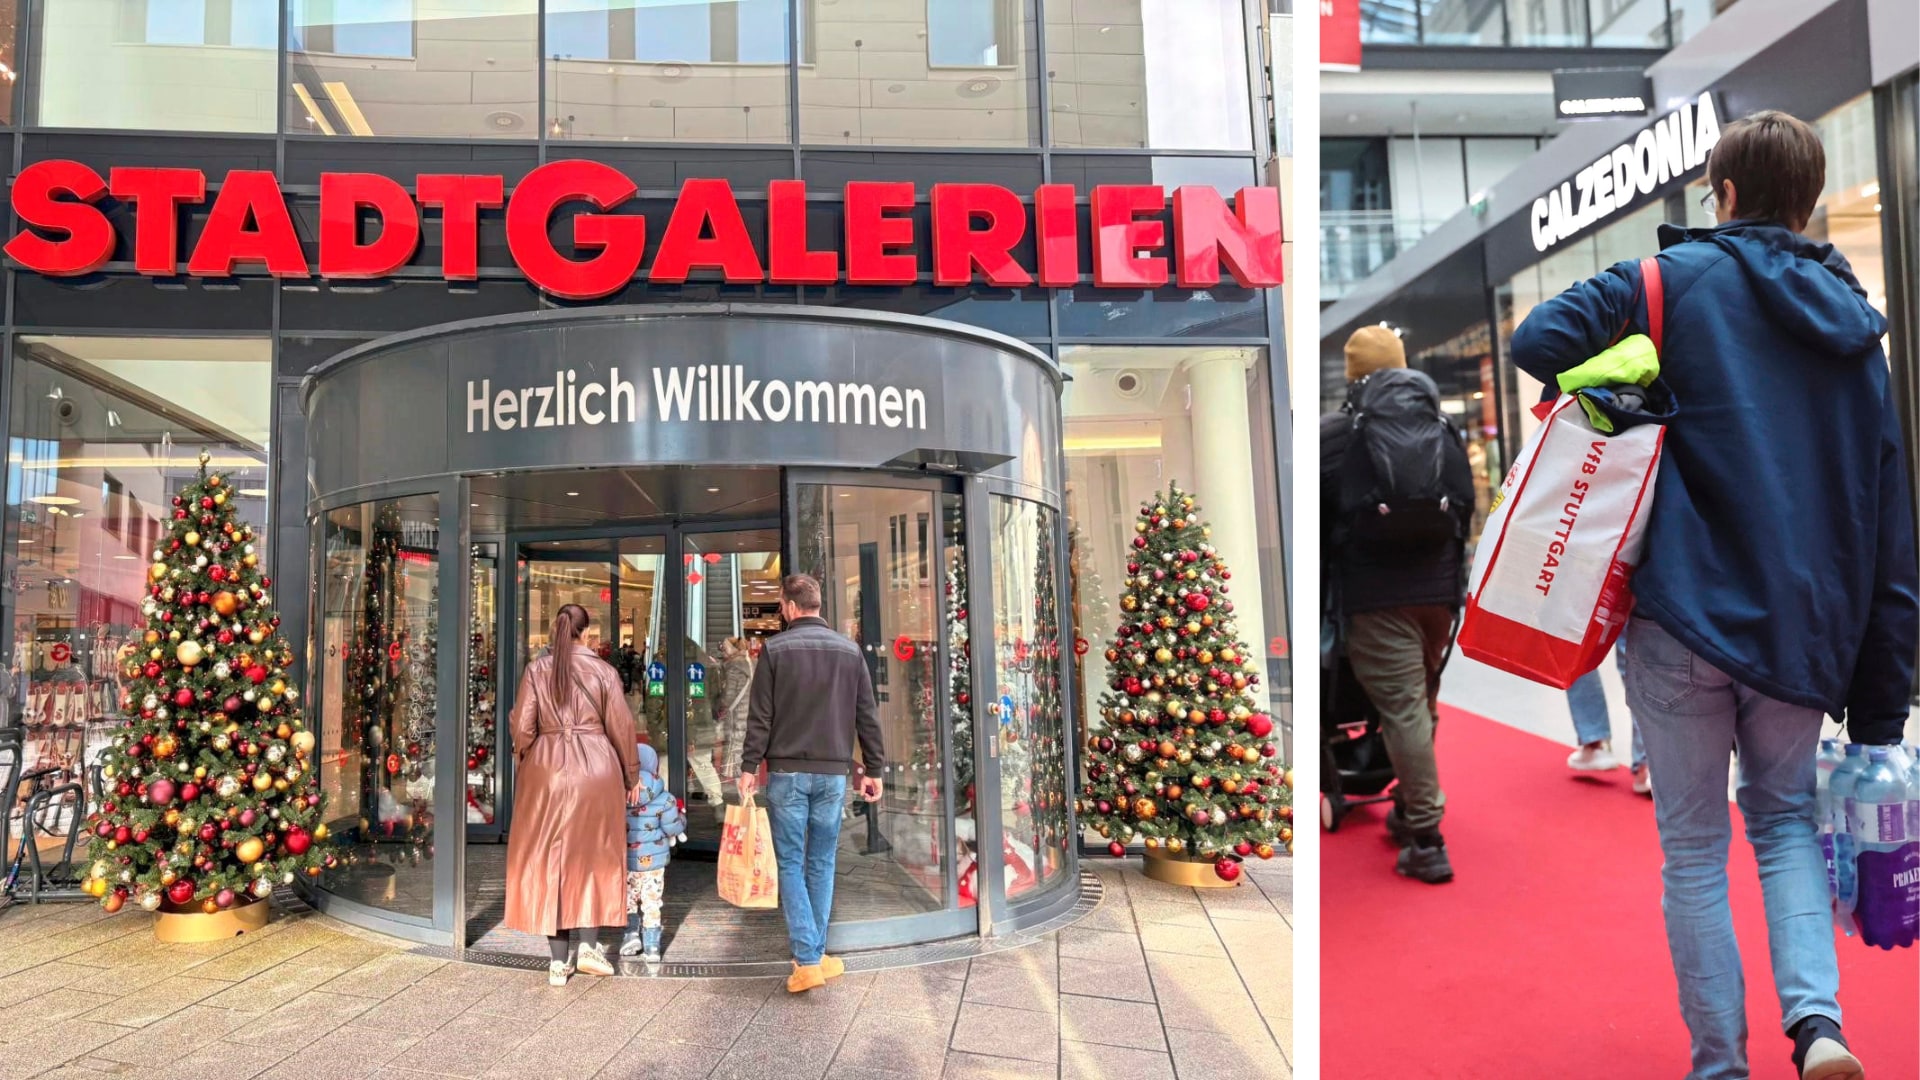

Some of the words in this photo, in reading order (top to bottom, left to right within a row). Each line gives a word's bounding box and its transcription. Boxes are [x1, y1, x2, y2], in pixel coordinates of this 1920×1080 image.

[4, 159, 1284, 298] STADTGALERIEN
[1530, 91, 1722, 253] CALZEDONIA
[466, 367, 638, 434] Herzlich
[652, 364, 928, 430] Willkommen
[1581, 440, 1606, 476] VfB
[1535, 480, 1590, 597] STUTTGART
